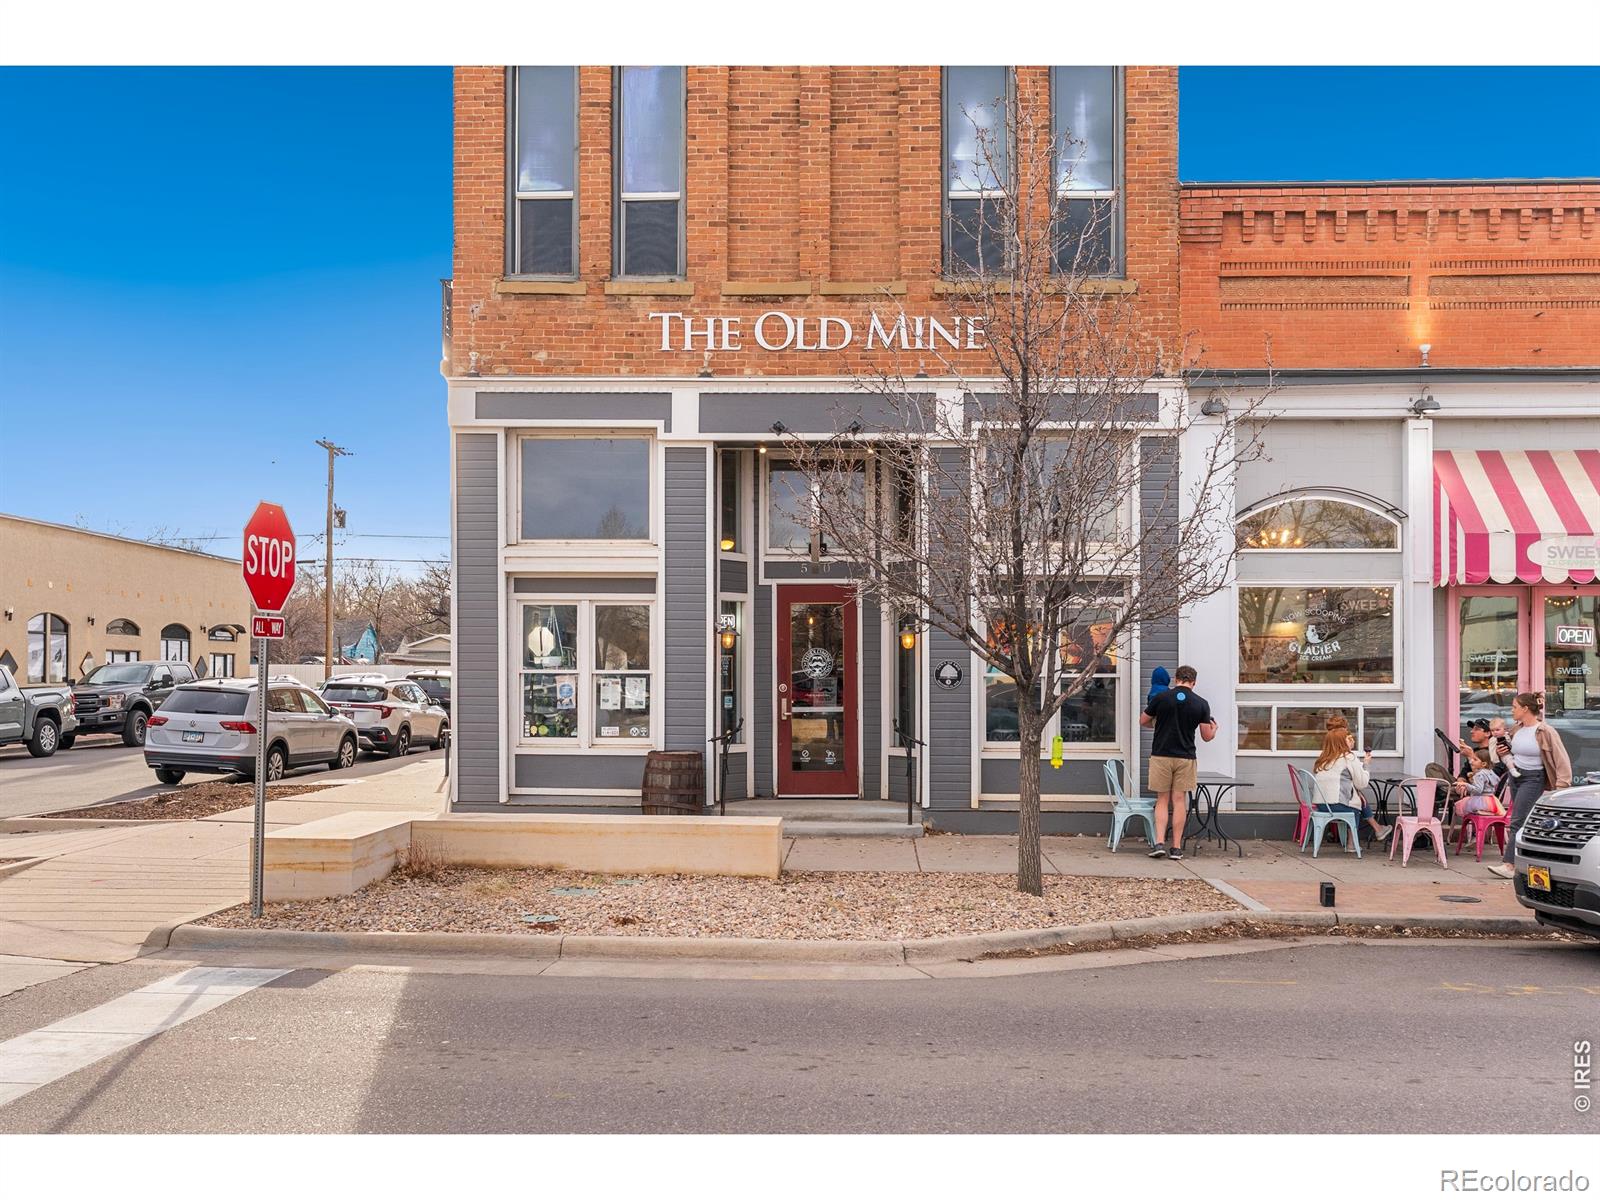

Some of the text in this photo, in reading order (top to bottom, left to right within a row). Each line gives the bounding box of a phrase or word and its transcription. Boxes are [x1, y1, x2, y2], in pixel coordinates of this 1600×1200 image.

[649, 311, 987, 351] THE OLD MINE
[246, 534, 293, 578] STOP
[1282, 608, 1347, 625] NOW SCOOPING
[255, 621, 282, 635] ALL WAY
[1559, 628, 1592, 644] OPEN
[1289, 640, 1341, 655] GLACIER
[1311, 654, 1333, 662] CREAM
